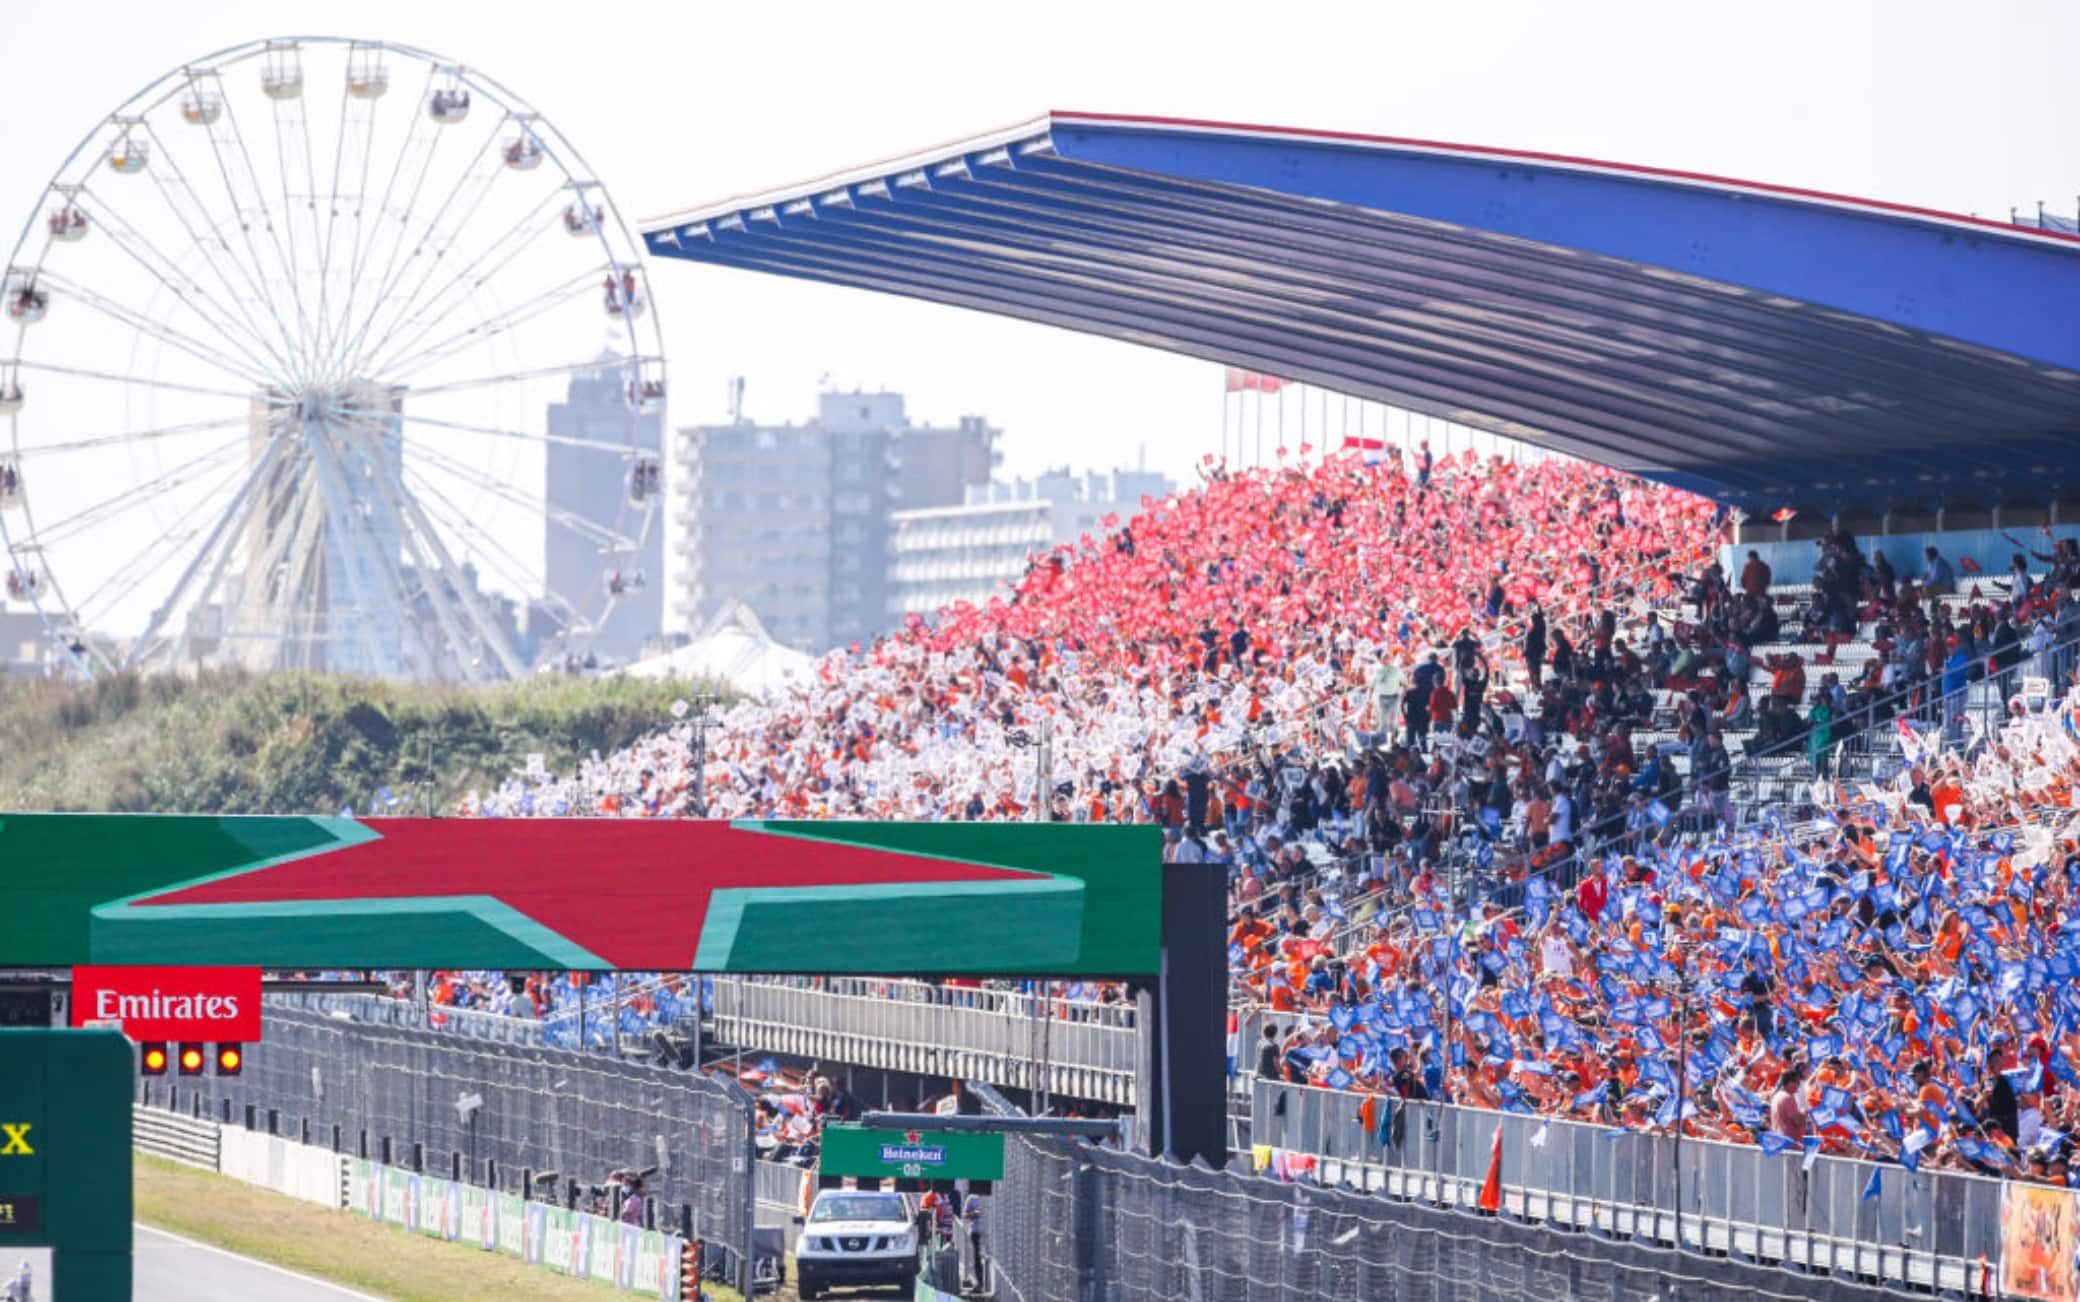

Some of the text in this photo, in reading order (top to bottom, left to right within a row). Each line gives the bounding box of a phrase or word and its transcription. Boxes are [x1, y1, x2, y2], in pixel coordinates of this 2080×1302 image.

[96, 988, 239, 1020] Emirates
[1, 1123, 34, 1154] X
[883, 1146, 942, 1161] Heineken
